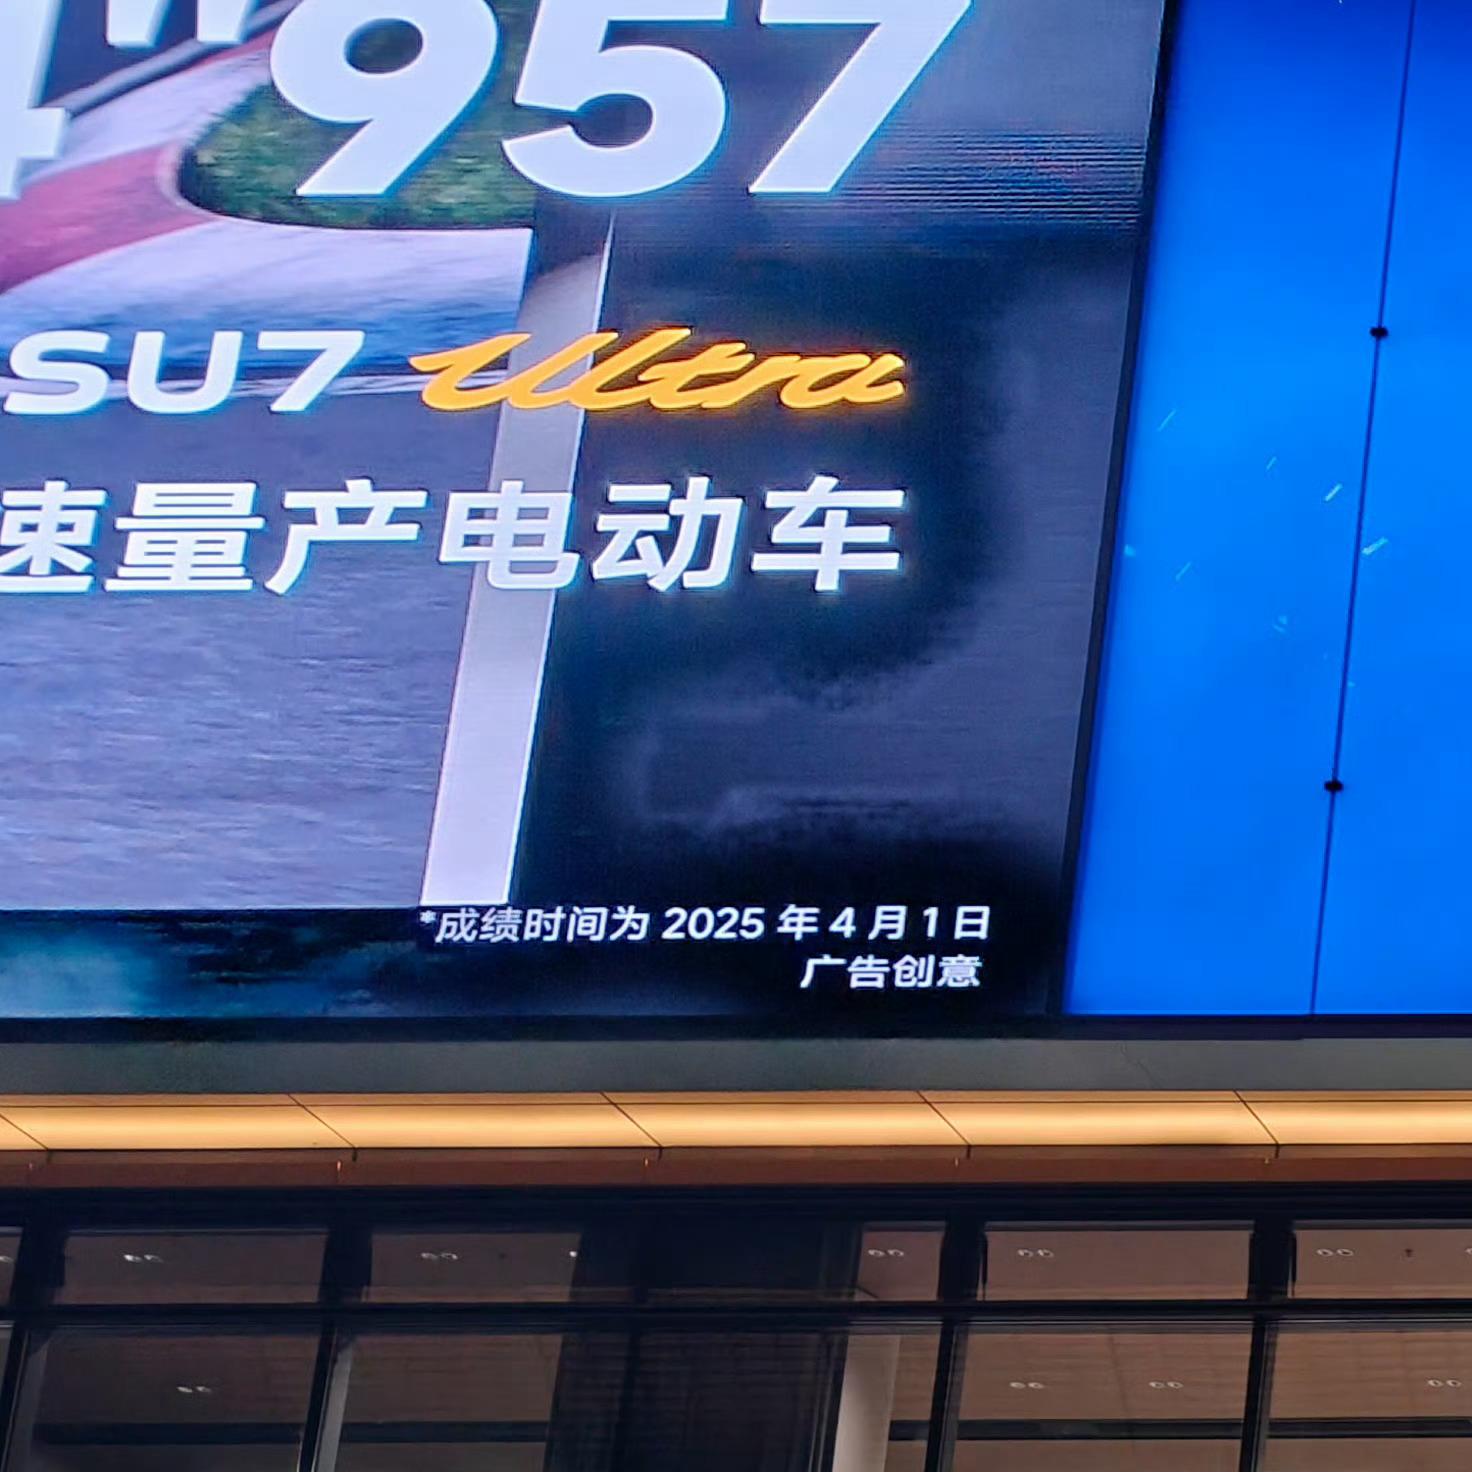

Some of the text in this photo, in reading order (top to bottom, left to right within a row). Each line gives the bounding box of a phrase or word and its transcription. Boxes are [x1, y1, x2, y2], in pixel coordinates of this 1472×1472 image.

[4, 328, 907, 414] SU7 Ultra
[0, 476, 905, 595] 速量产电动车
[662, 907, 765, 939] 2025
[777, 903, 820, 941] 年
[829, 907, 857, 938] 4
[867, 905, 908, 941] 月
[923, 907, 939, 938] 1
[953, 905, 991, 940] 日
[799, 953, 983, 989] 广告创意
